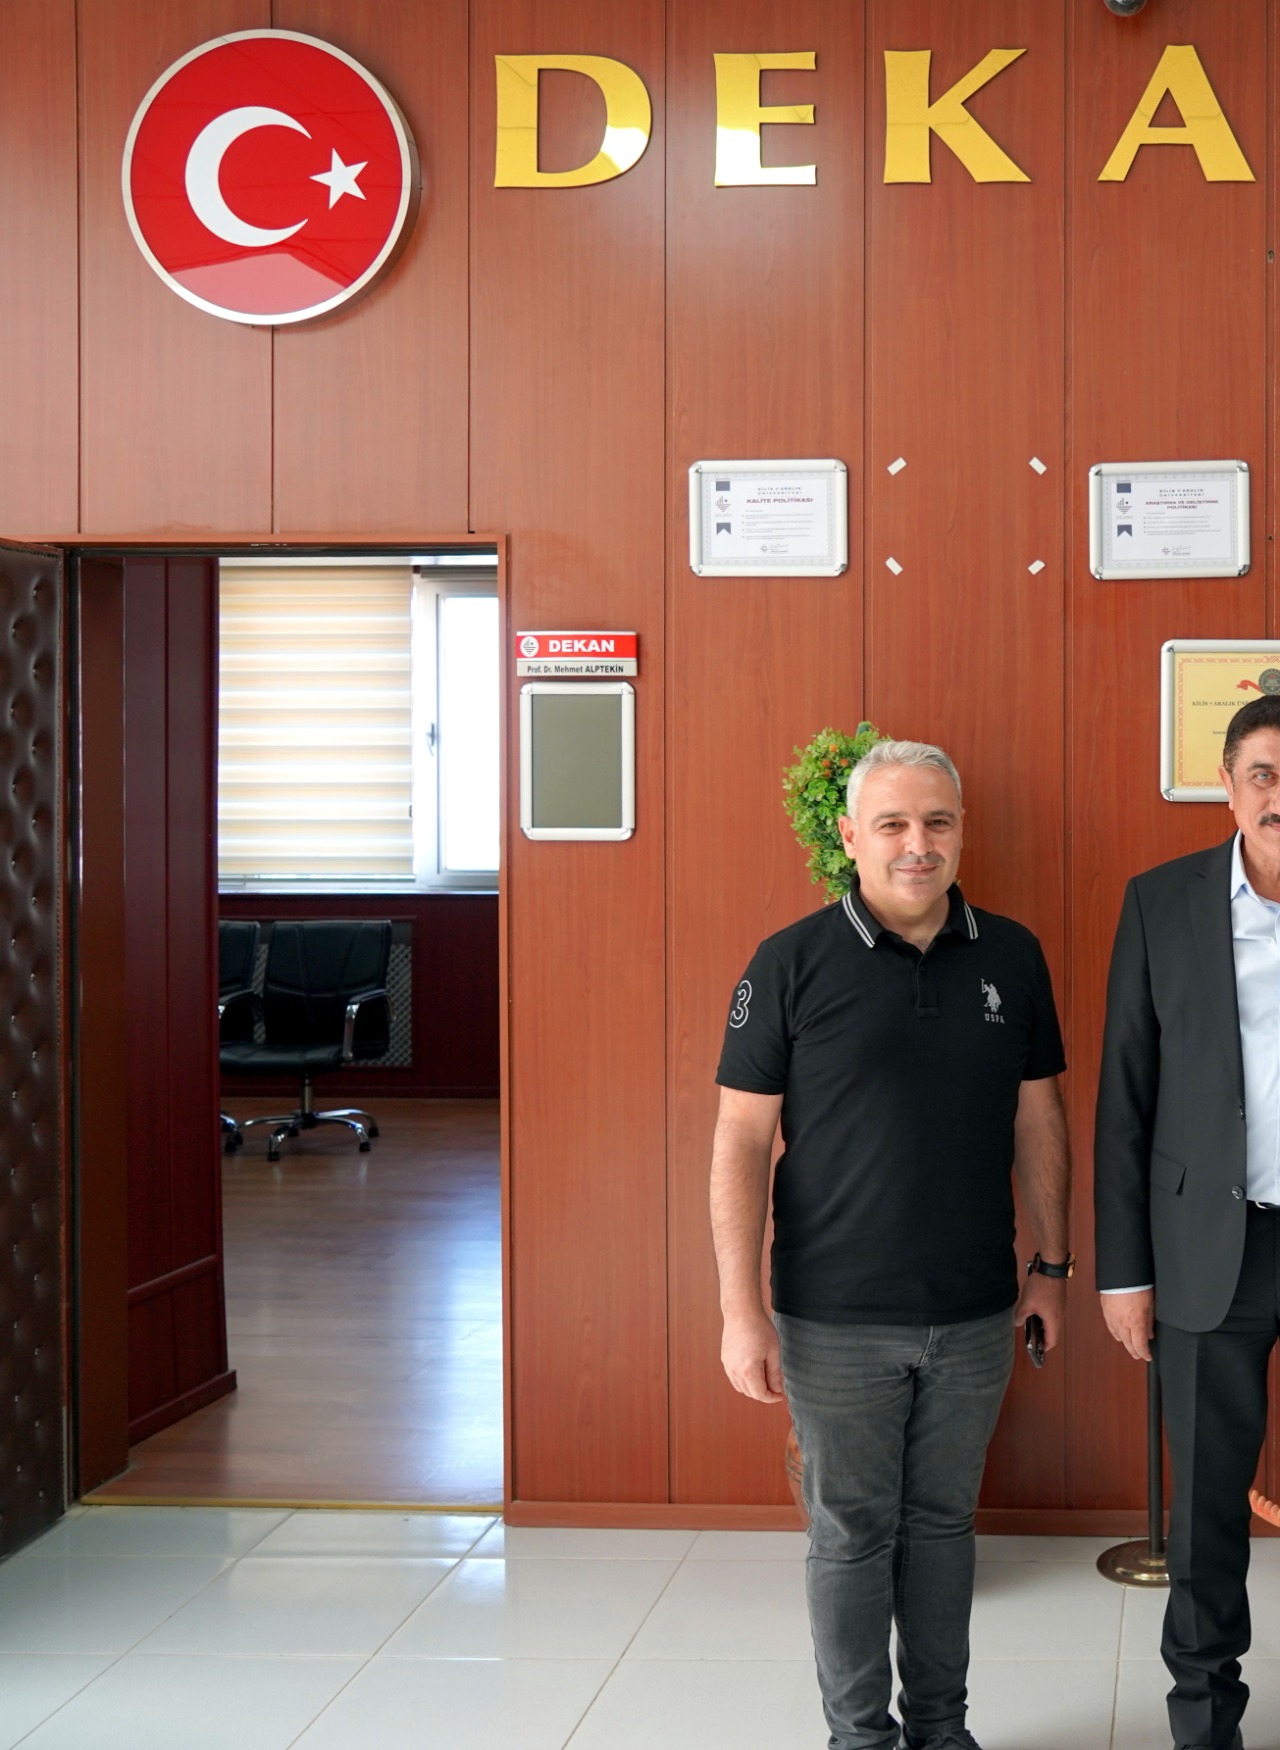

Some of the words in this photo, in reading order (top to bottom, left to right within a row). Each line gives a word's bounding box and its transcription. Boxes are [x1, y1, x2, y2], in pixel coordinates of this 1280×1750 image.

[548, 639, 615, 653] DEKAN
[527, 665, 542, 673] Prof.
[544, 665, 552, 673] Dr.
[554, 665, 584, 673] Mehmet
[585, 664, 624, 673] ALPTEKİN
[730, 980, 753, 1028] 3
[984, 1013, 1005, 1024] USPA
